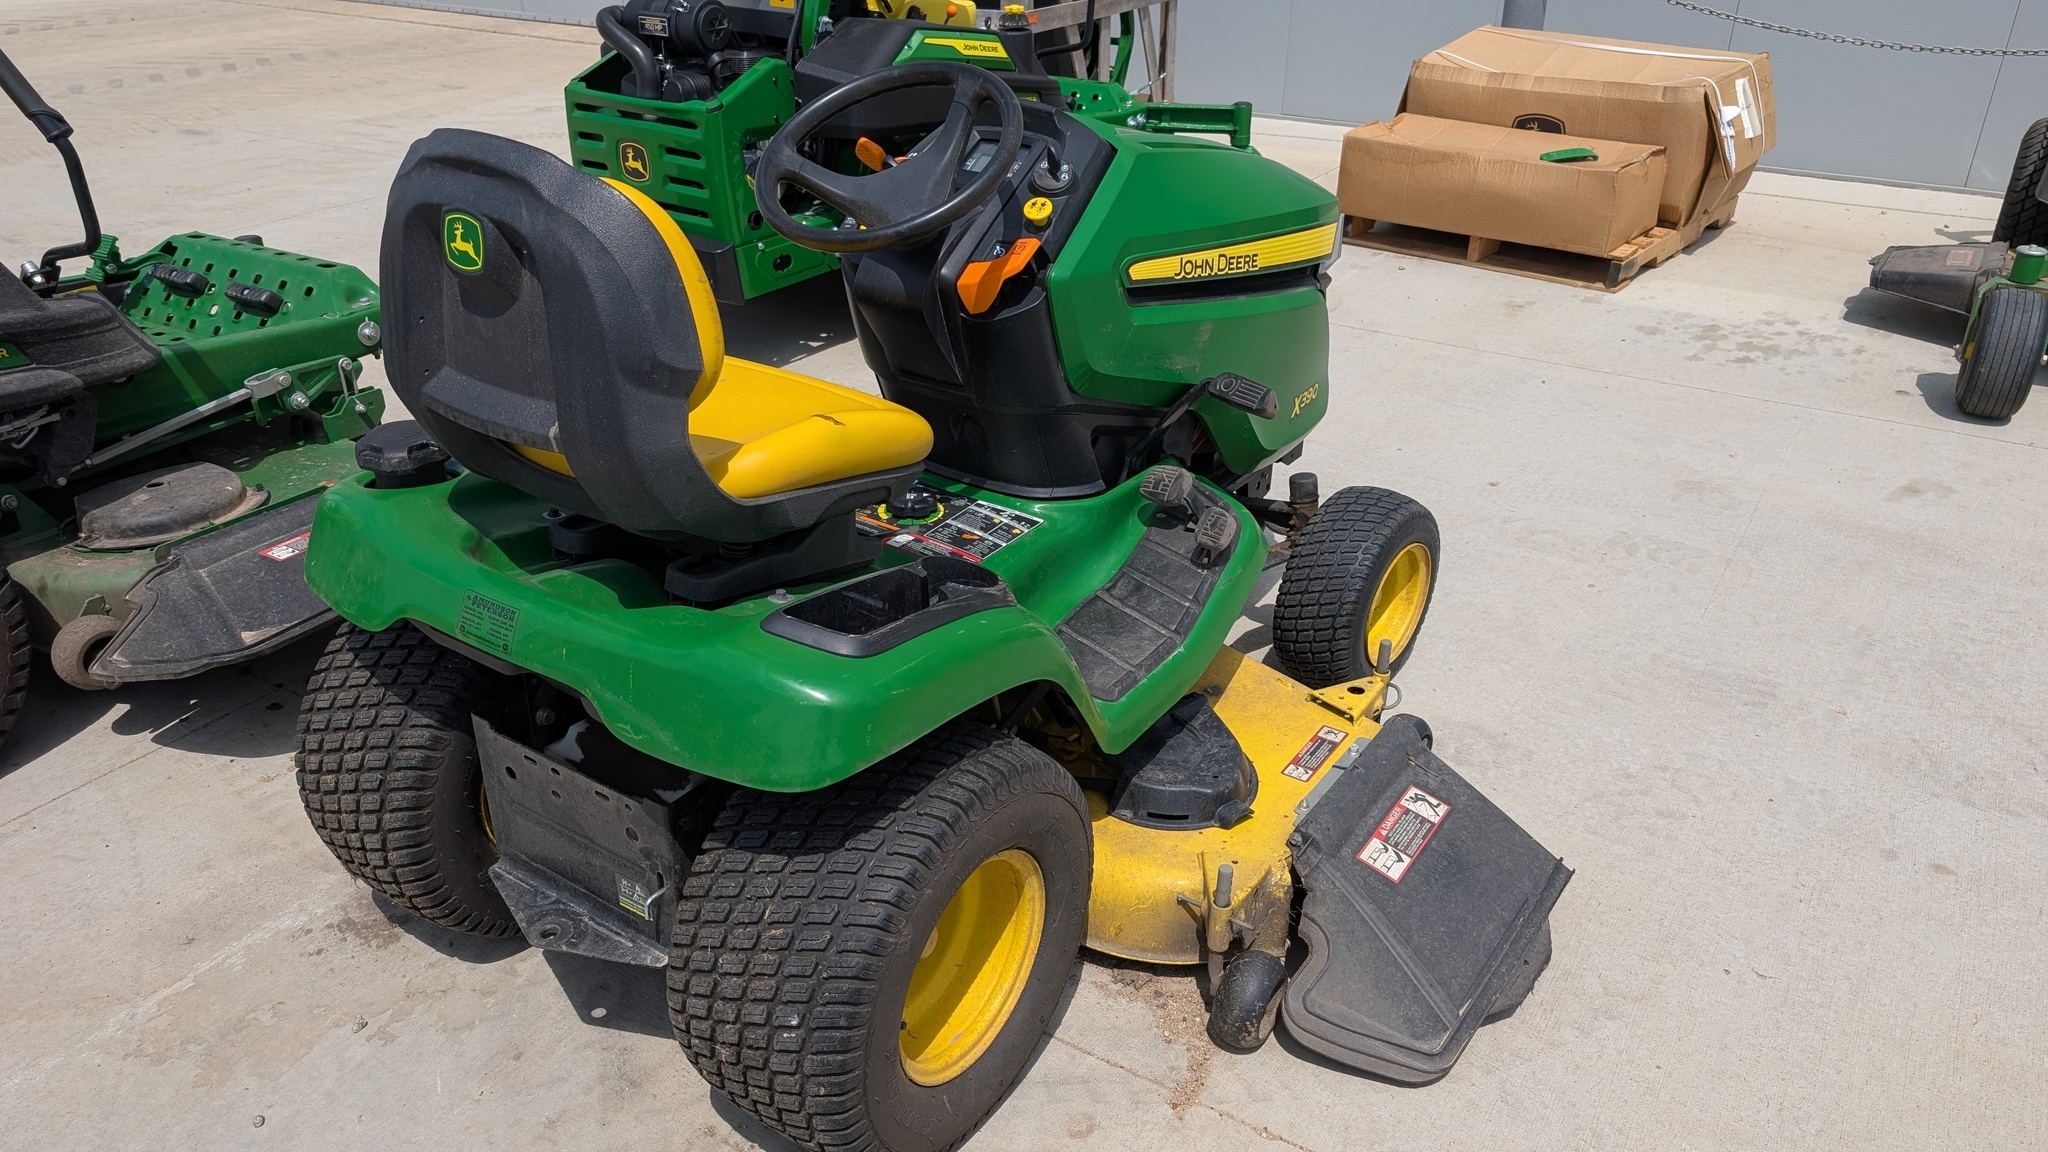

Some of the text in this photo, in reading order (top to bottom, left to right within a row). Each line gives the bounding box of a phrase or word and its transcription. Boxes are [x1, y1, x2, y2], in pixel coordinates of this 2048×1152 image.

[963, 43, 999, 53] JOHN DEERE
[1174, 253, 1259, 278] JOHN DEERE
[1291, 383, 1319, 419] X390
[471, 601, 516, 622] PETERSON
[472, 594, 517, 616] AMUNDSON
[1384, 806, 1402, 831] DANGER
[1045, 819, 1073, 844] TURF
